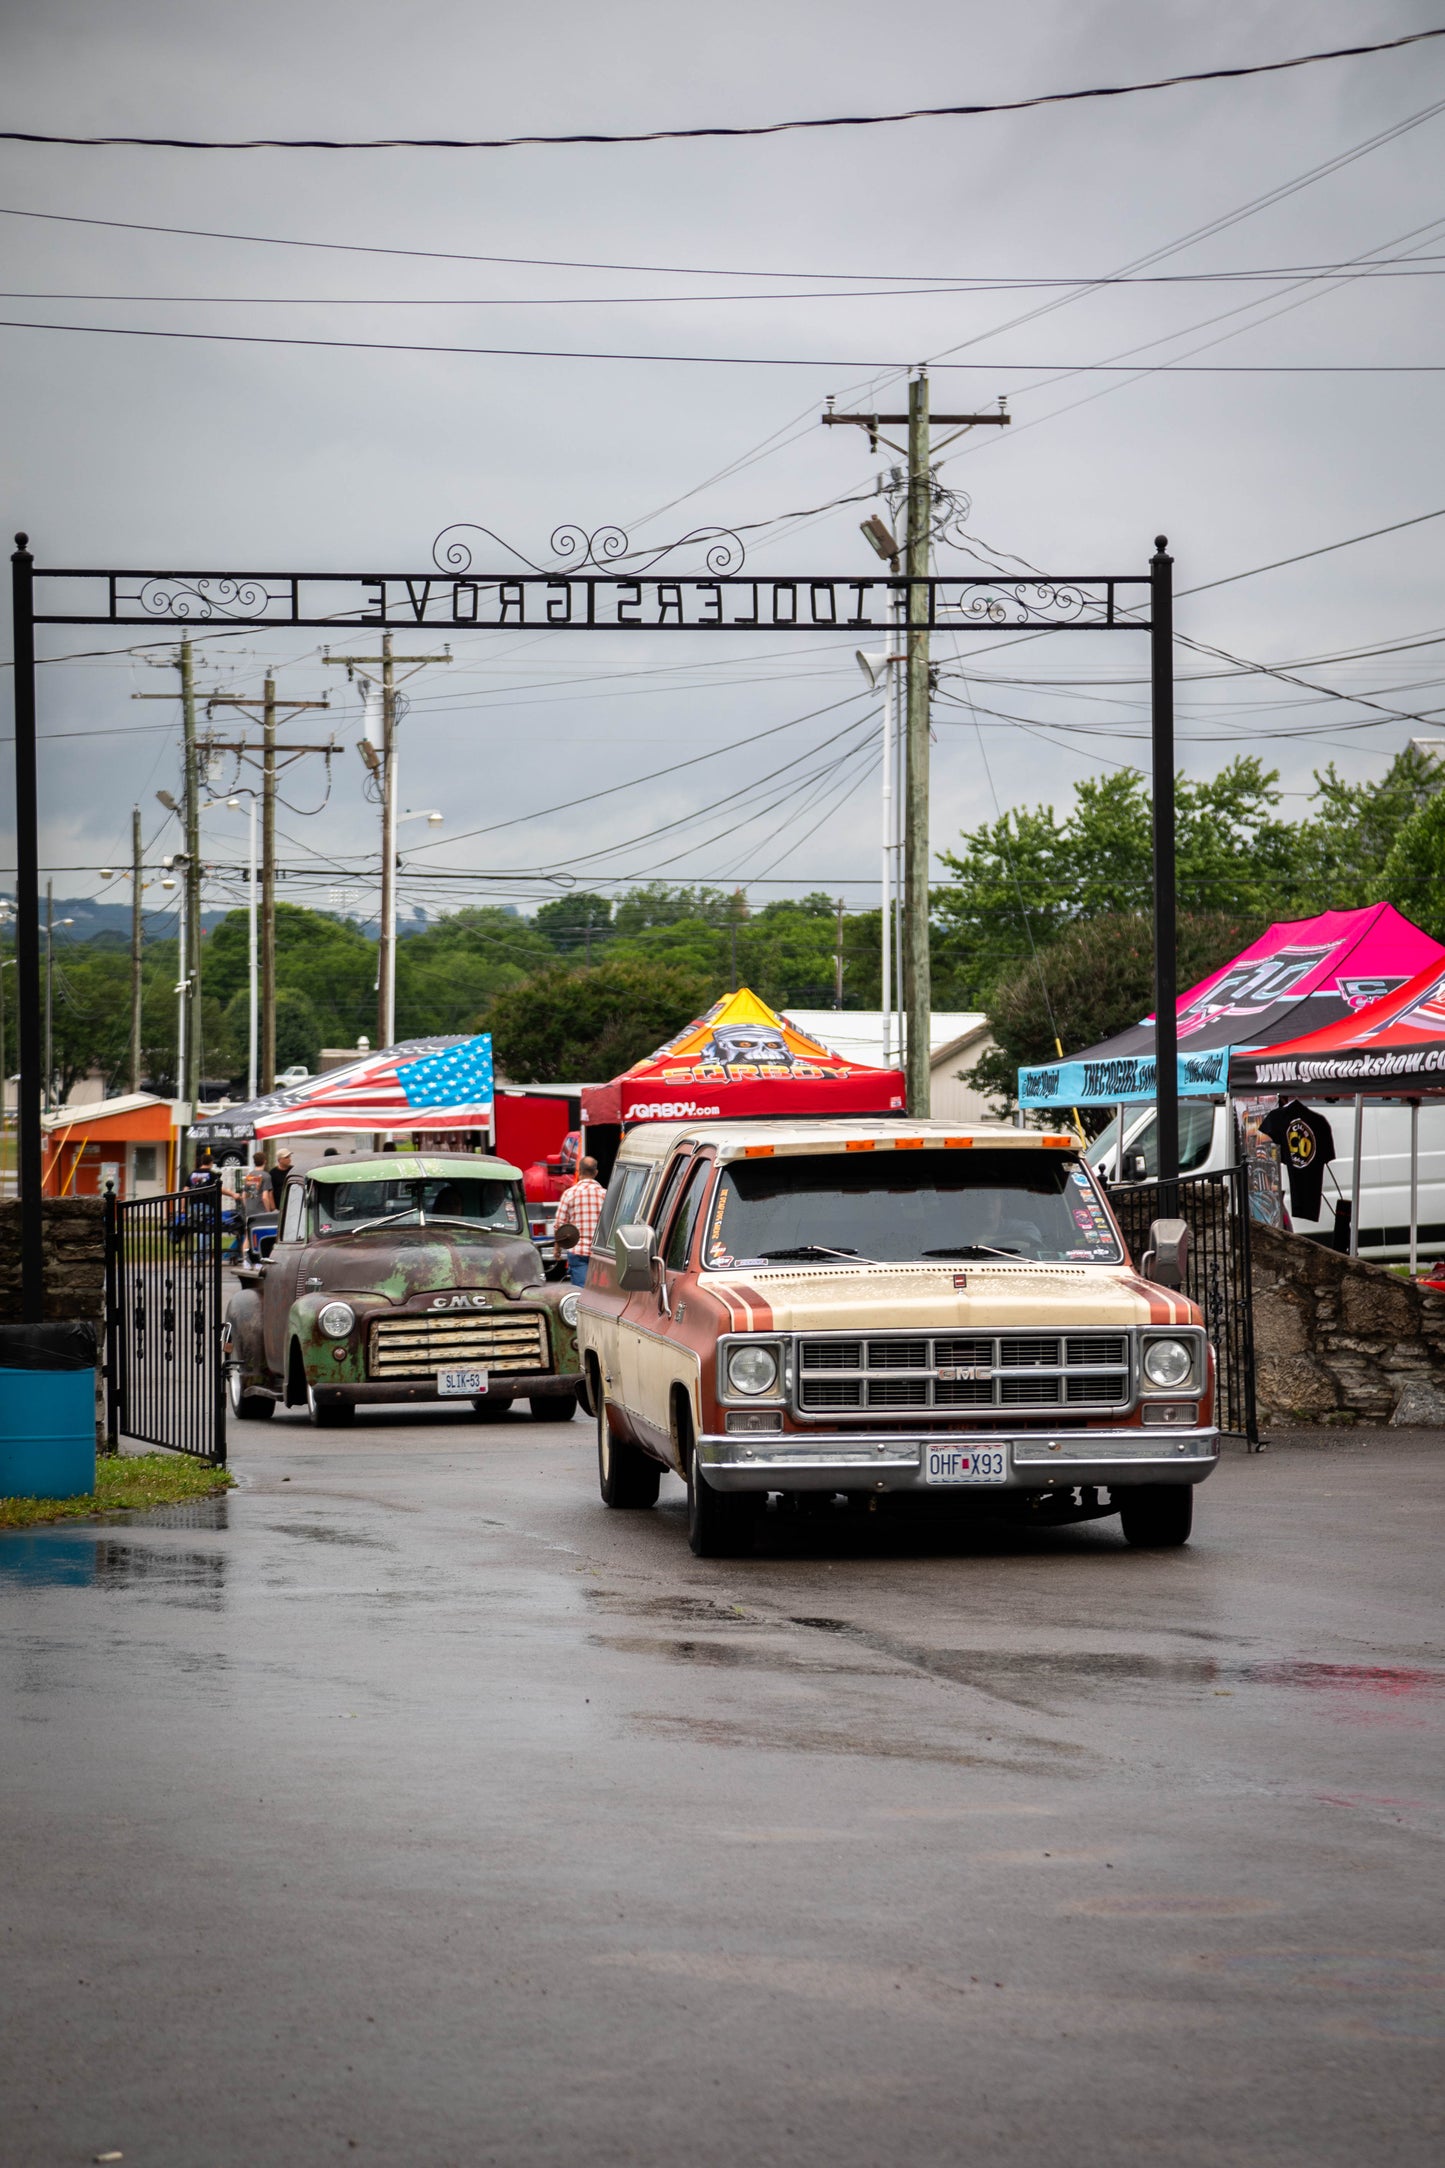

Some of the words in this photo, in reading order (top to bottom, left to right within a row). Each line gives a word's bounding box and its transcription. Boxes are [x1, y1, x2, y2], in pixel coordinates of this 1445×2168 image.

[433, 1295, 486, 1308] GMC
[446, 1374, 480, 1388] SLIK-53
[938, 1367, 993, 1381] GMC
[971, 1453, 1003, 1474] X93
